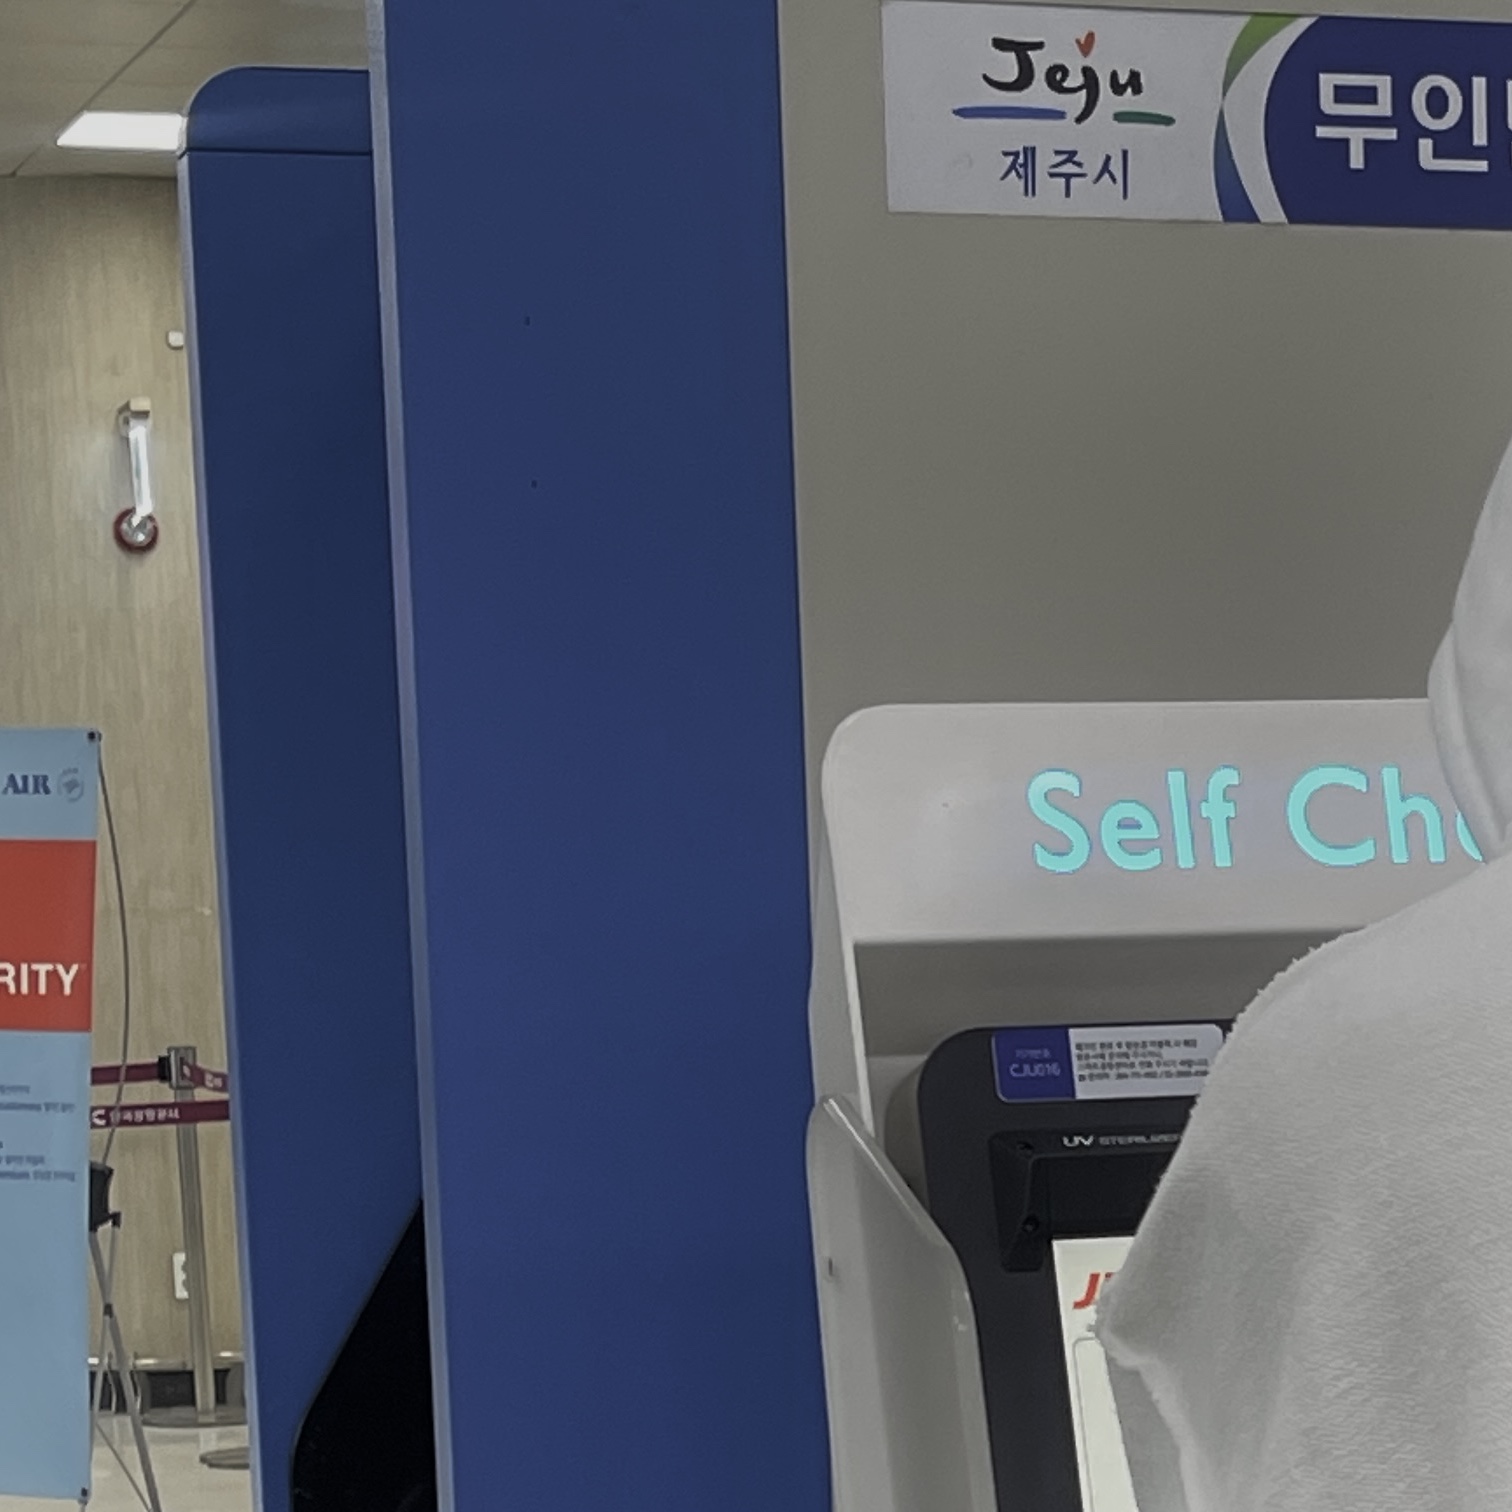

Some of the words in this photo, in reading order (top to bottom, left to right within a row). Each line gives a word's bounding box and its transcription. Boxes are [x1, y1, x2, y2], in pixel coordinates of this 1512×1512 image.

[982, 32, 1144, 125] Jeju
[1000, 145, 1130, 200] 제주시
[2, 773, 52, 796] AIR
[1027, 764, 1240, 874] Self
[1287, 764, 1484, 867] Ch
[1062, 1135, 1094, 1147] UV
